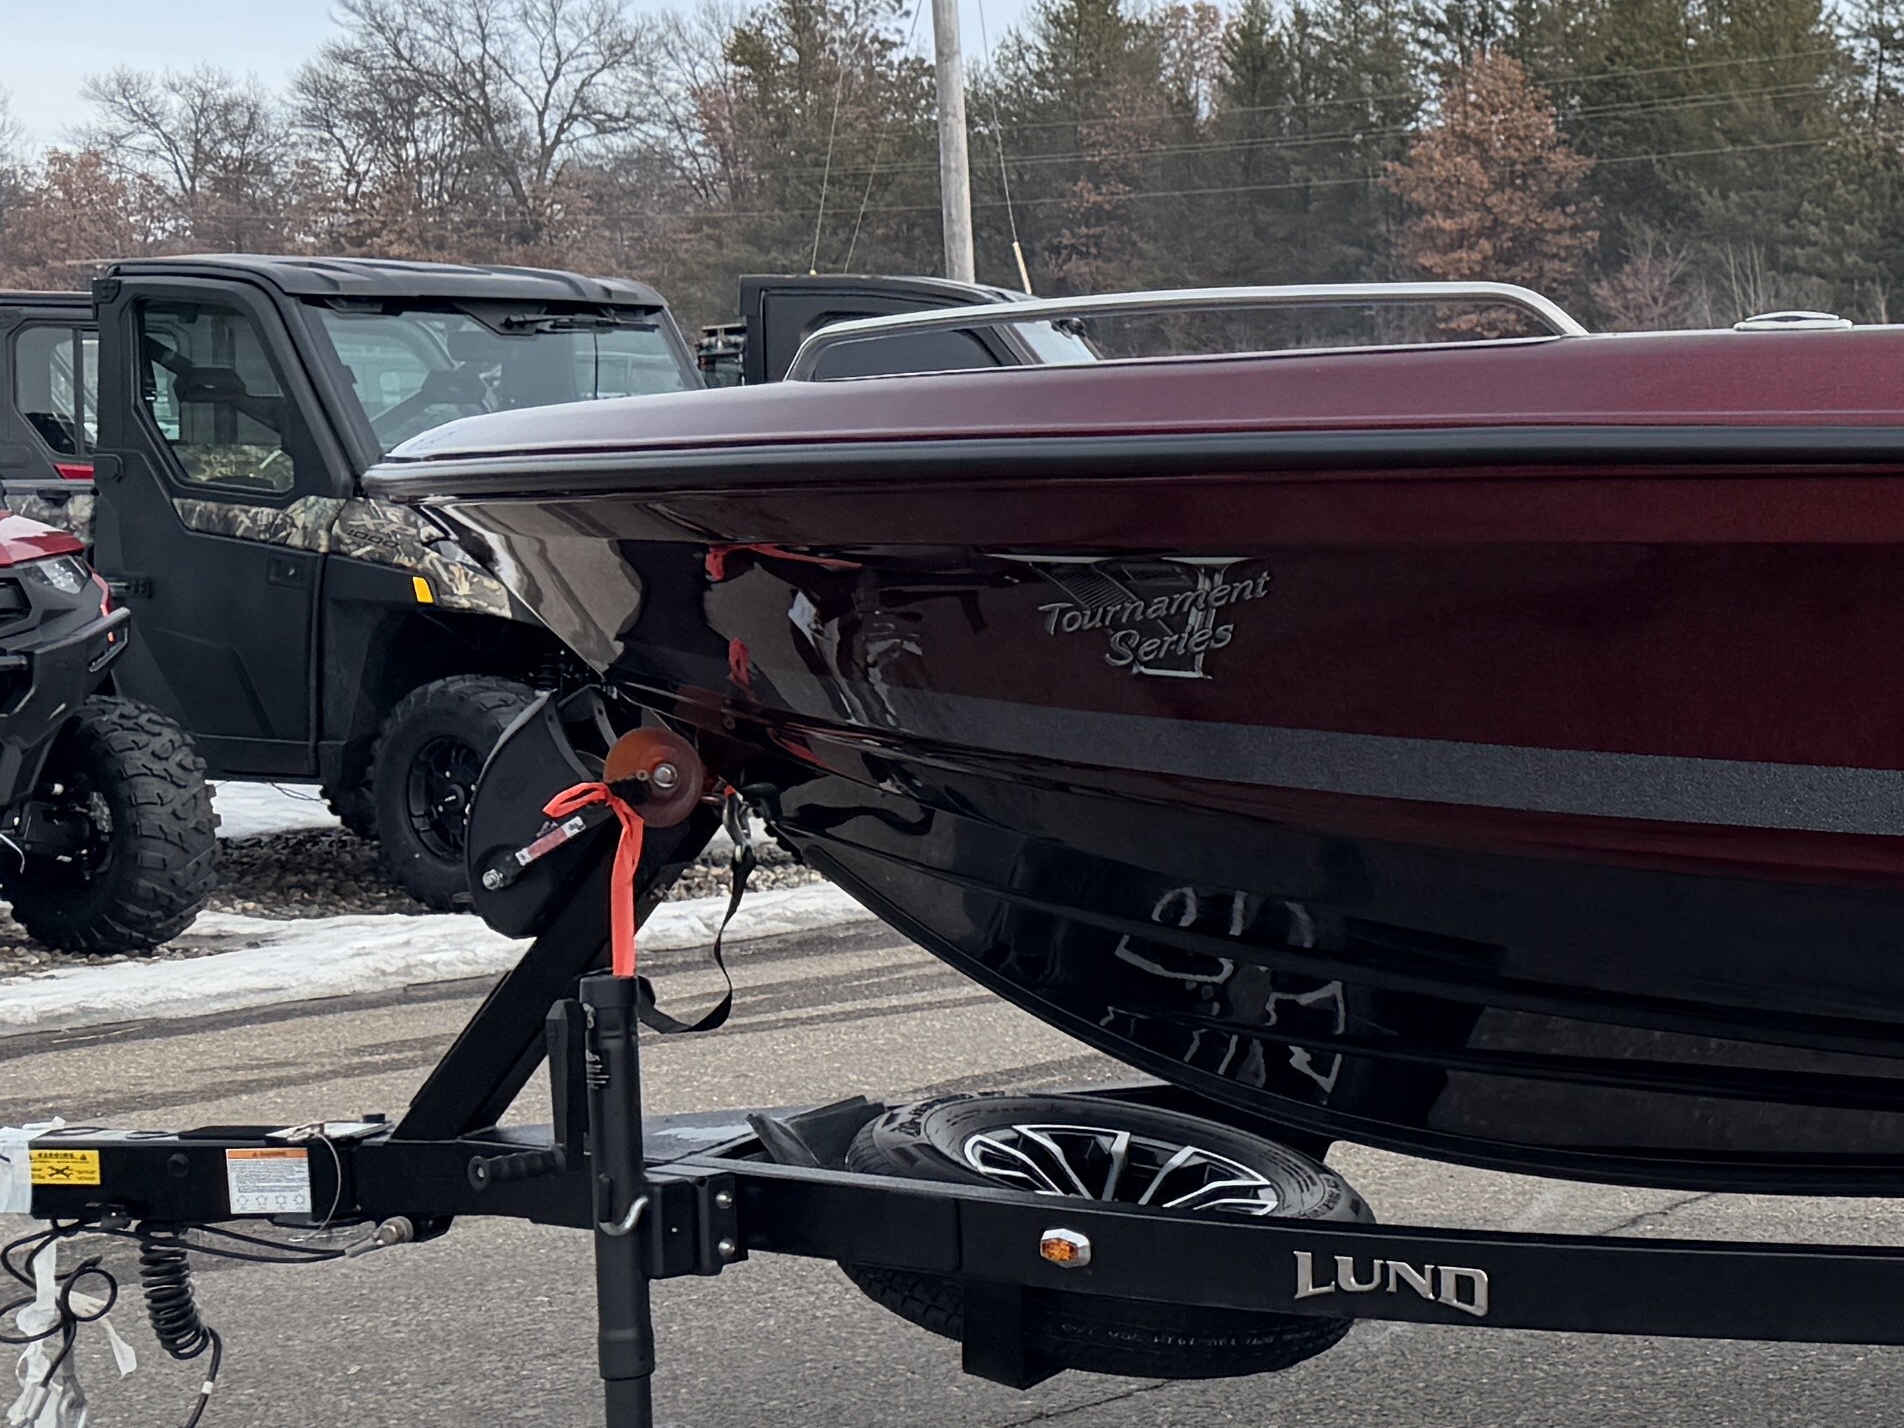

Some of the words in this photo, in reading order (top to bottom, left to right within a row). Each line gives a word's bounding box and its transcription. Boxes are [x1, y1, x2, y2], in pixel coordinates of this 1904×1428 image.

[1037, 571, 1270, 635] Tournament
[1104, 622, 1235, 667] Series
[1293, 1250, 1489, 1317] LUND
